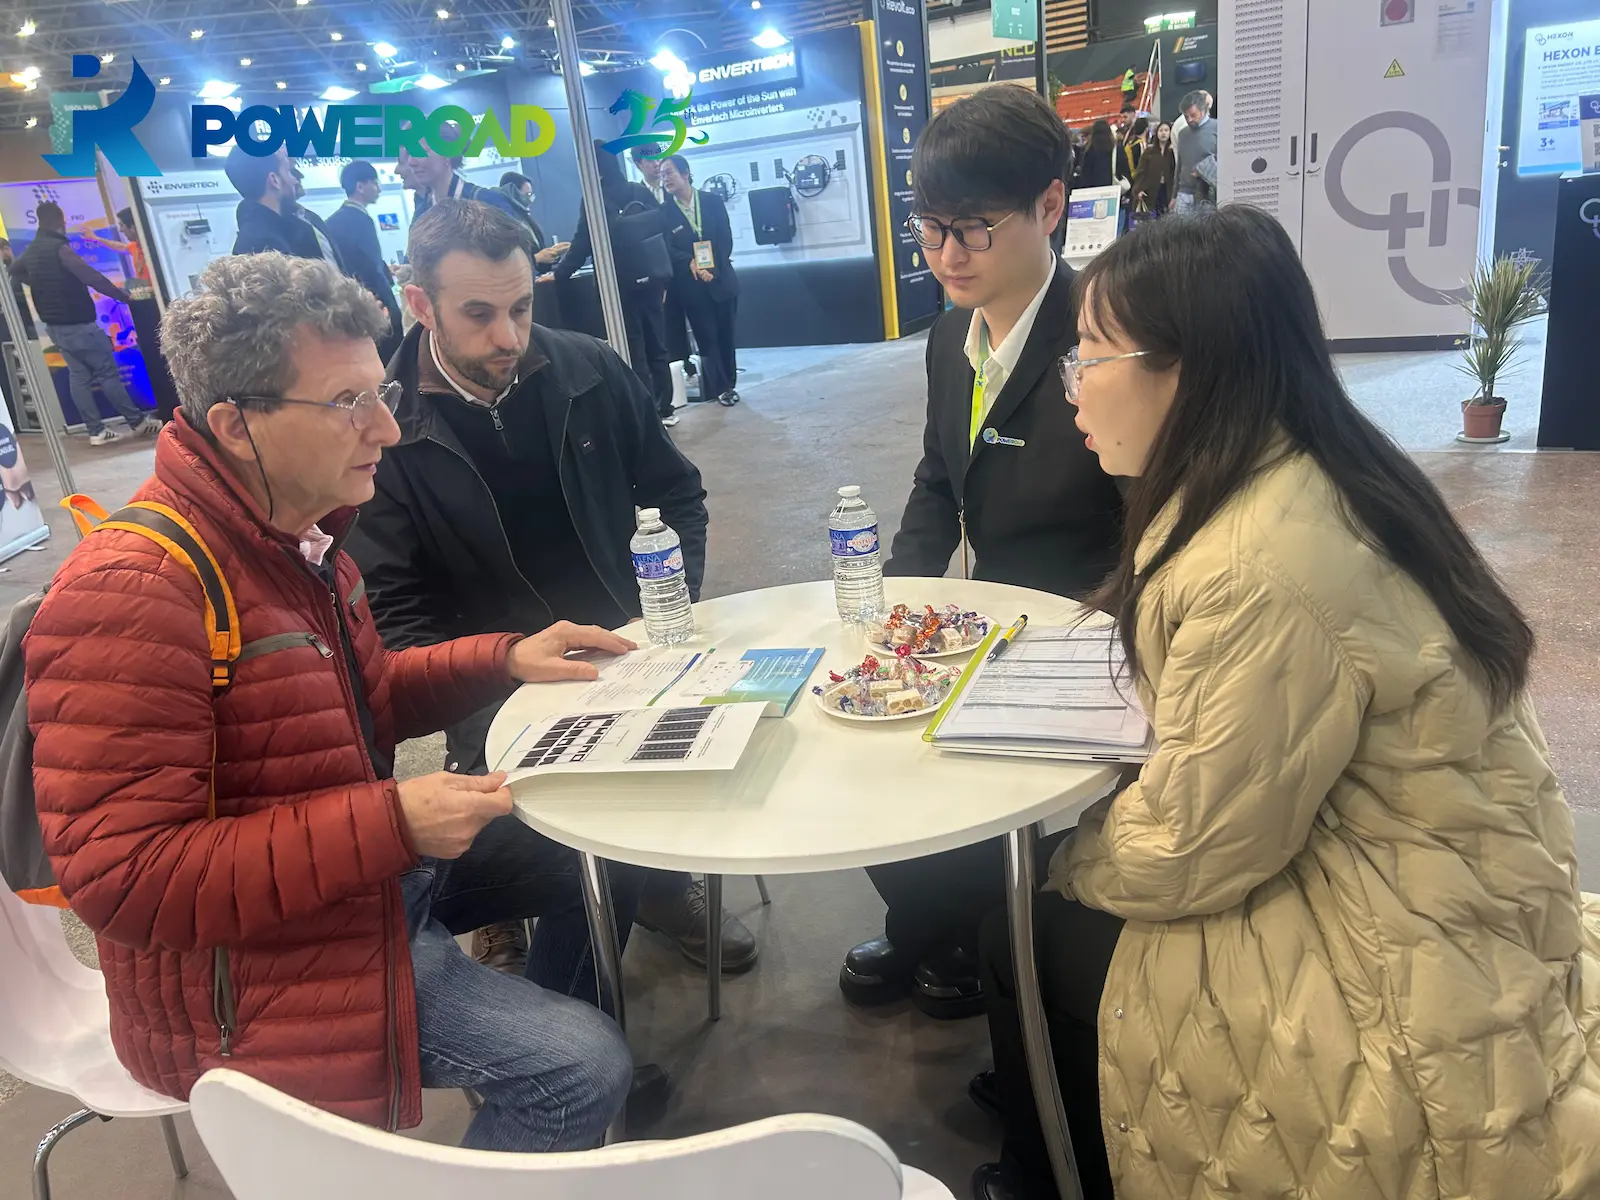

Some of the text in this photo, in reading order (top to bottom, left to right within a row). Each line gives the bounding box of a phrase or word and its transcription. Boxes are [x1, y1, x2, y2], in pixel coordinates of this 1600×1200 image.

[1547, 31, 1574, 40] HEXON
[1543, 46, 1591, 62] HEXON
[699, 52, 796, 83] ENVERTECH
[697, 103, 710, 112] the
[711, 98, 736, 111] Power
[737, 96, 747, 106] of
[747, 94, 760, 104] the
[761, 90, 779, 102] Sun
[779, 87, 798, 98] with
[729, 102, 785, 120] Microinverters
[163, 181, 219, 191] ENVERTECH
